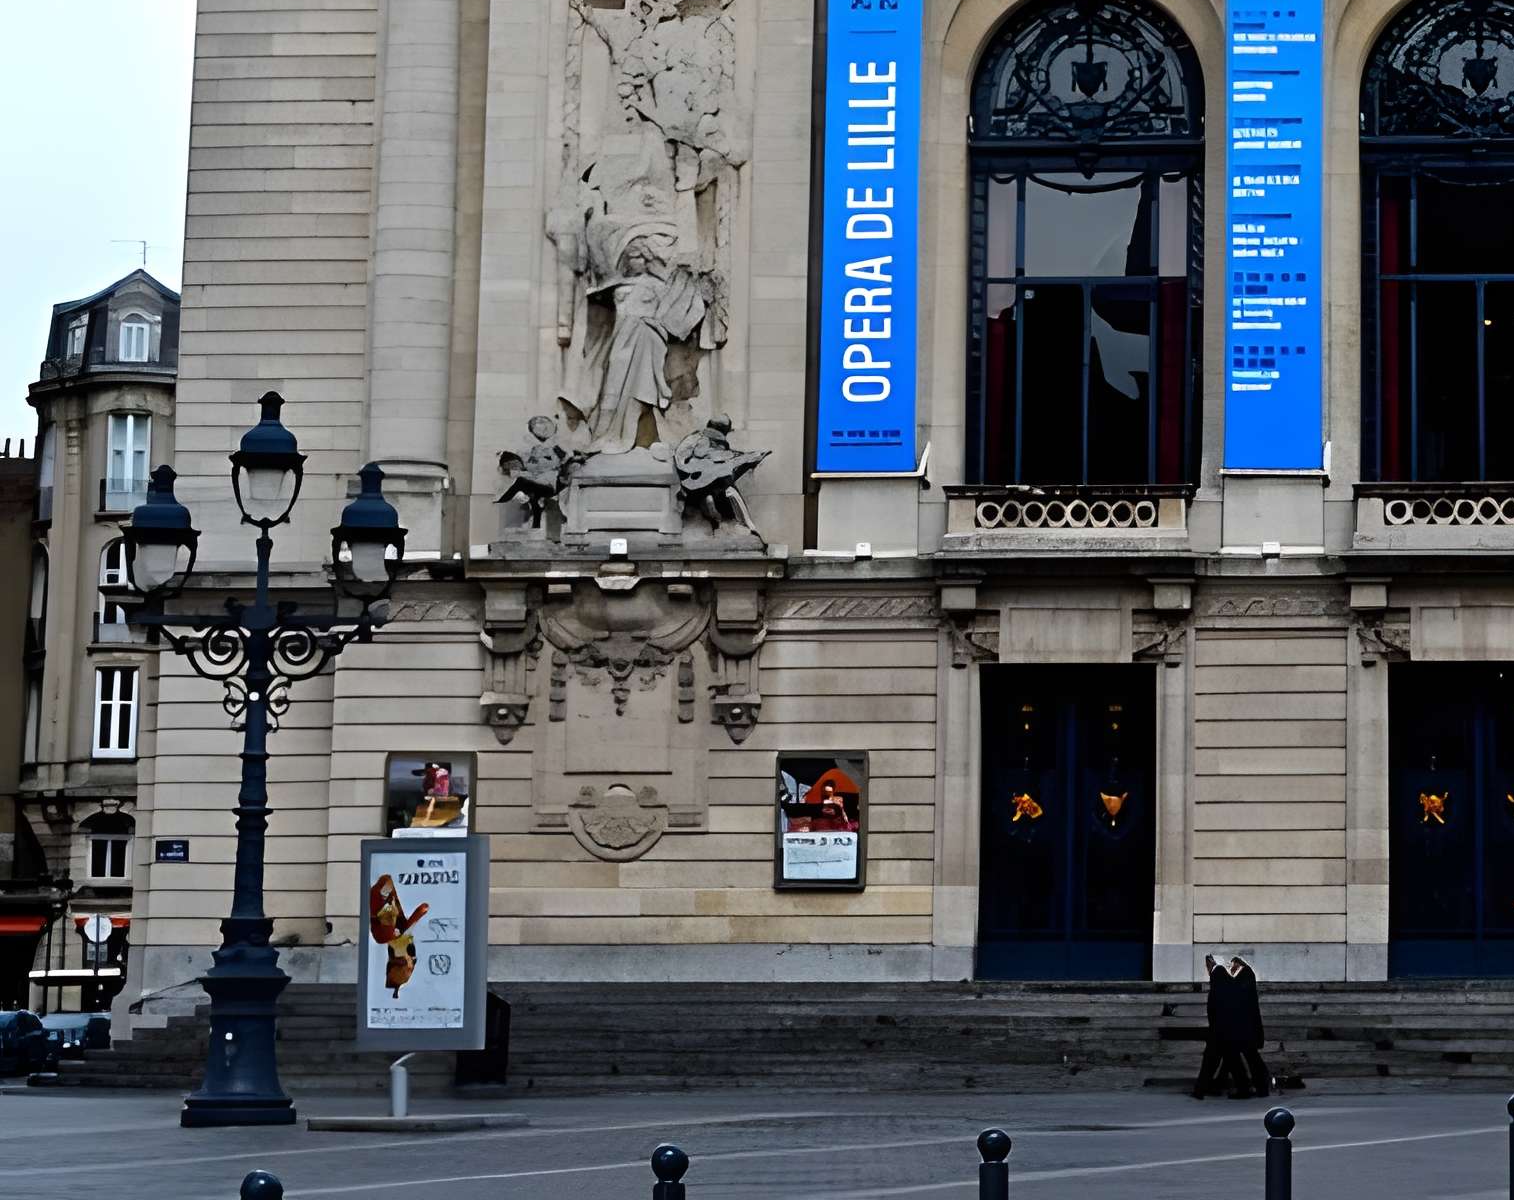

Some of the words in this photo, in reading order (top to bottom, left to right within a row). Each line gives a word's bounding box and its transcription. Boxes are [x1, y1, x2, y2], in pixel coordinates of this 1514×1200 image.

[847, 61, 897, 170] LILLE
[846, 187, 894, 239] DE
[842, 255, 892, 403] OPERA
